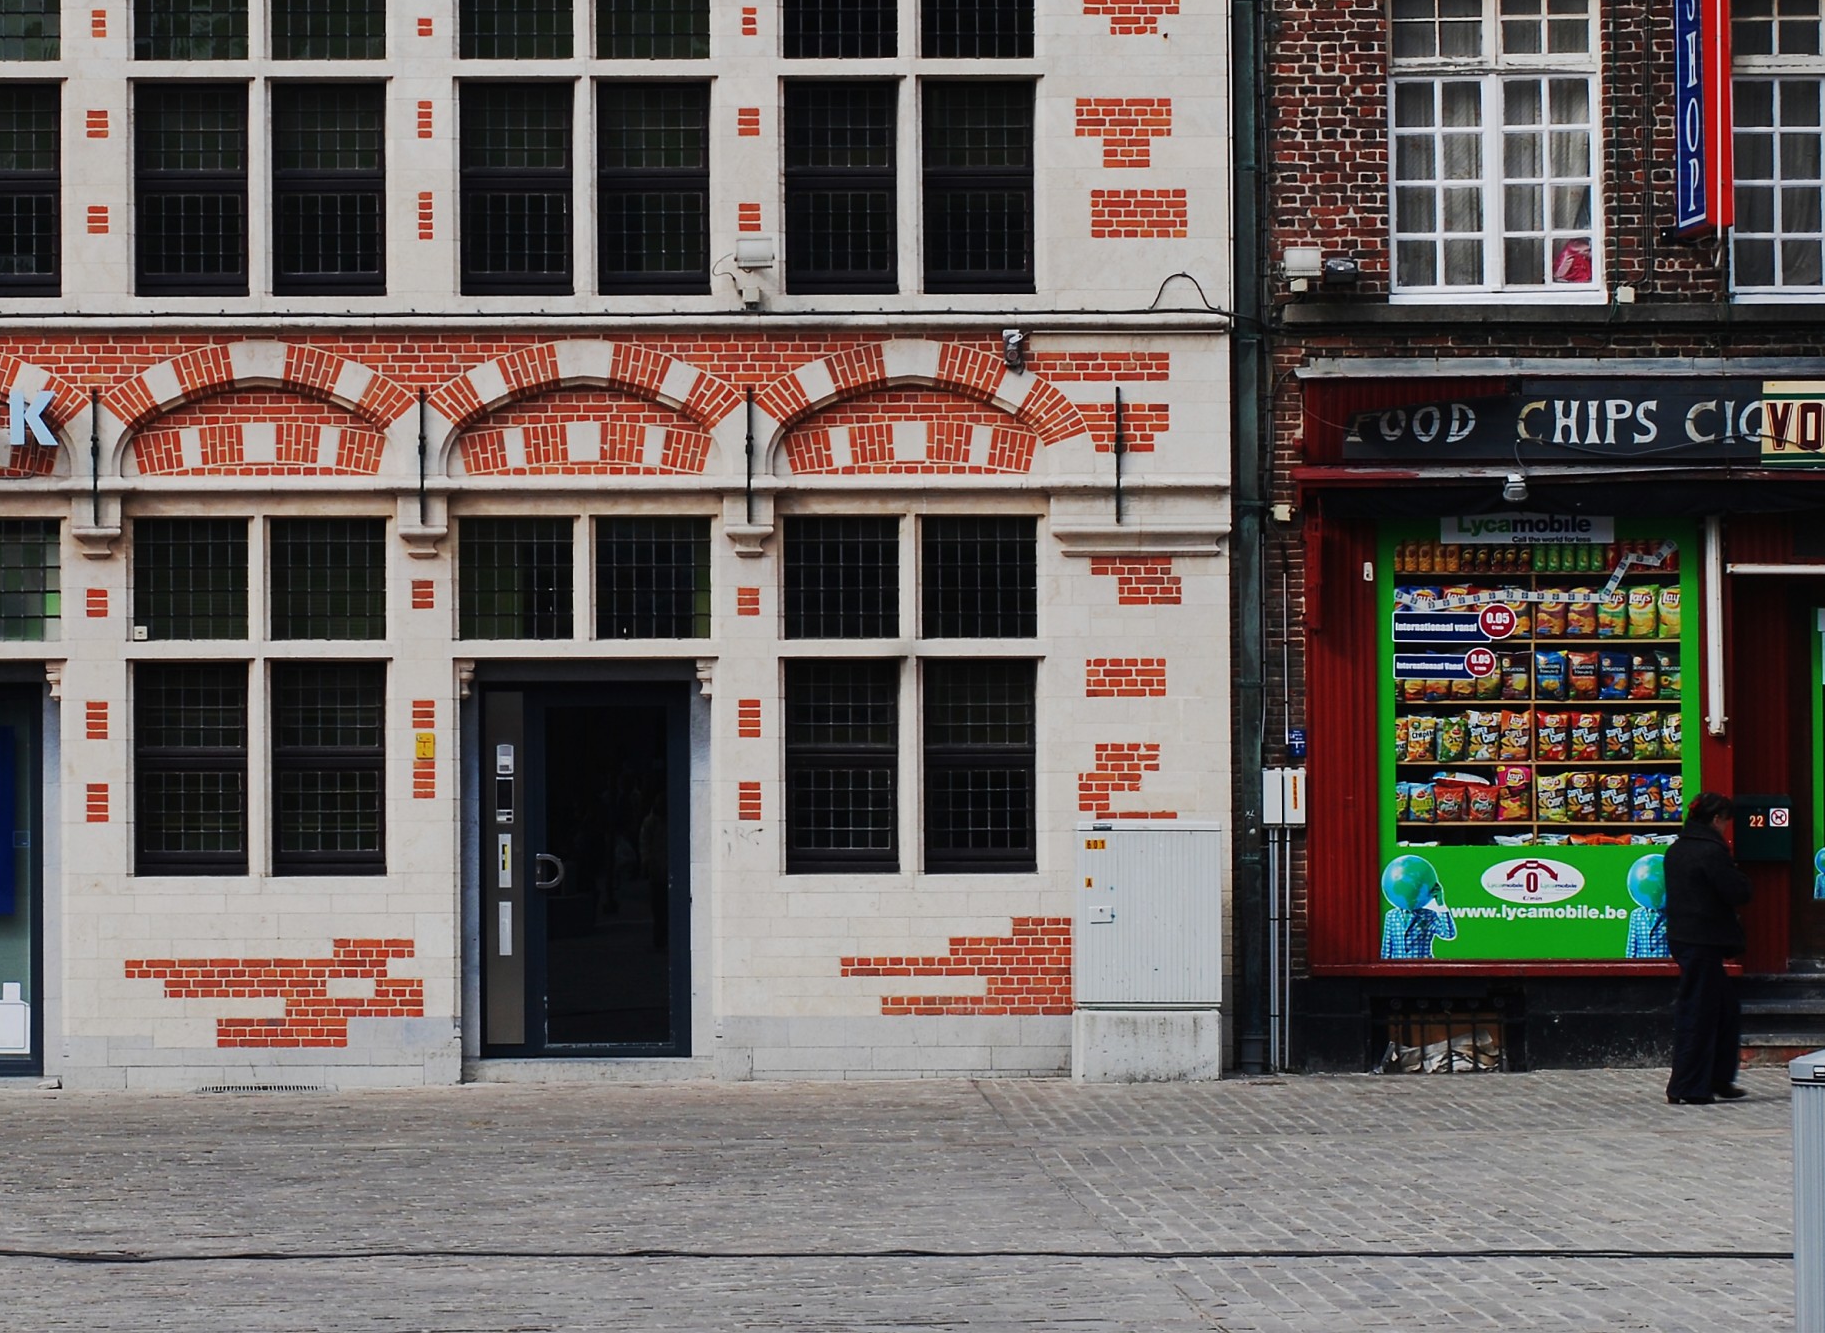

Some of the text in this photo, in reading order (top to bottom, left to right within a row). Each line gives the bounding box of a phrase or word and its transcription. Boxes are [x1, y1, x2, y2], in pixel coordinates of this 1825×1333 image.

[1345, 403, 1476, 443] FOOD
[1517, 399, 1658, 445] CHIPS
[1457, 515, 1591, 537] Lycamobile
[1486, 612, 1510, 624] 0.05
[1471, 654, 1490, 664] 0.05
[1749, 814, 1765, 827] 22
[1086, 839, 1106, 850] 601
[1451, 904, 1628, 921] www.lycamobile.be
